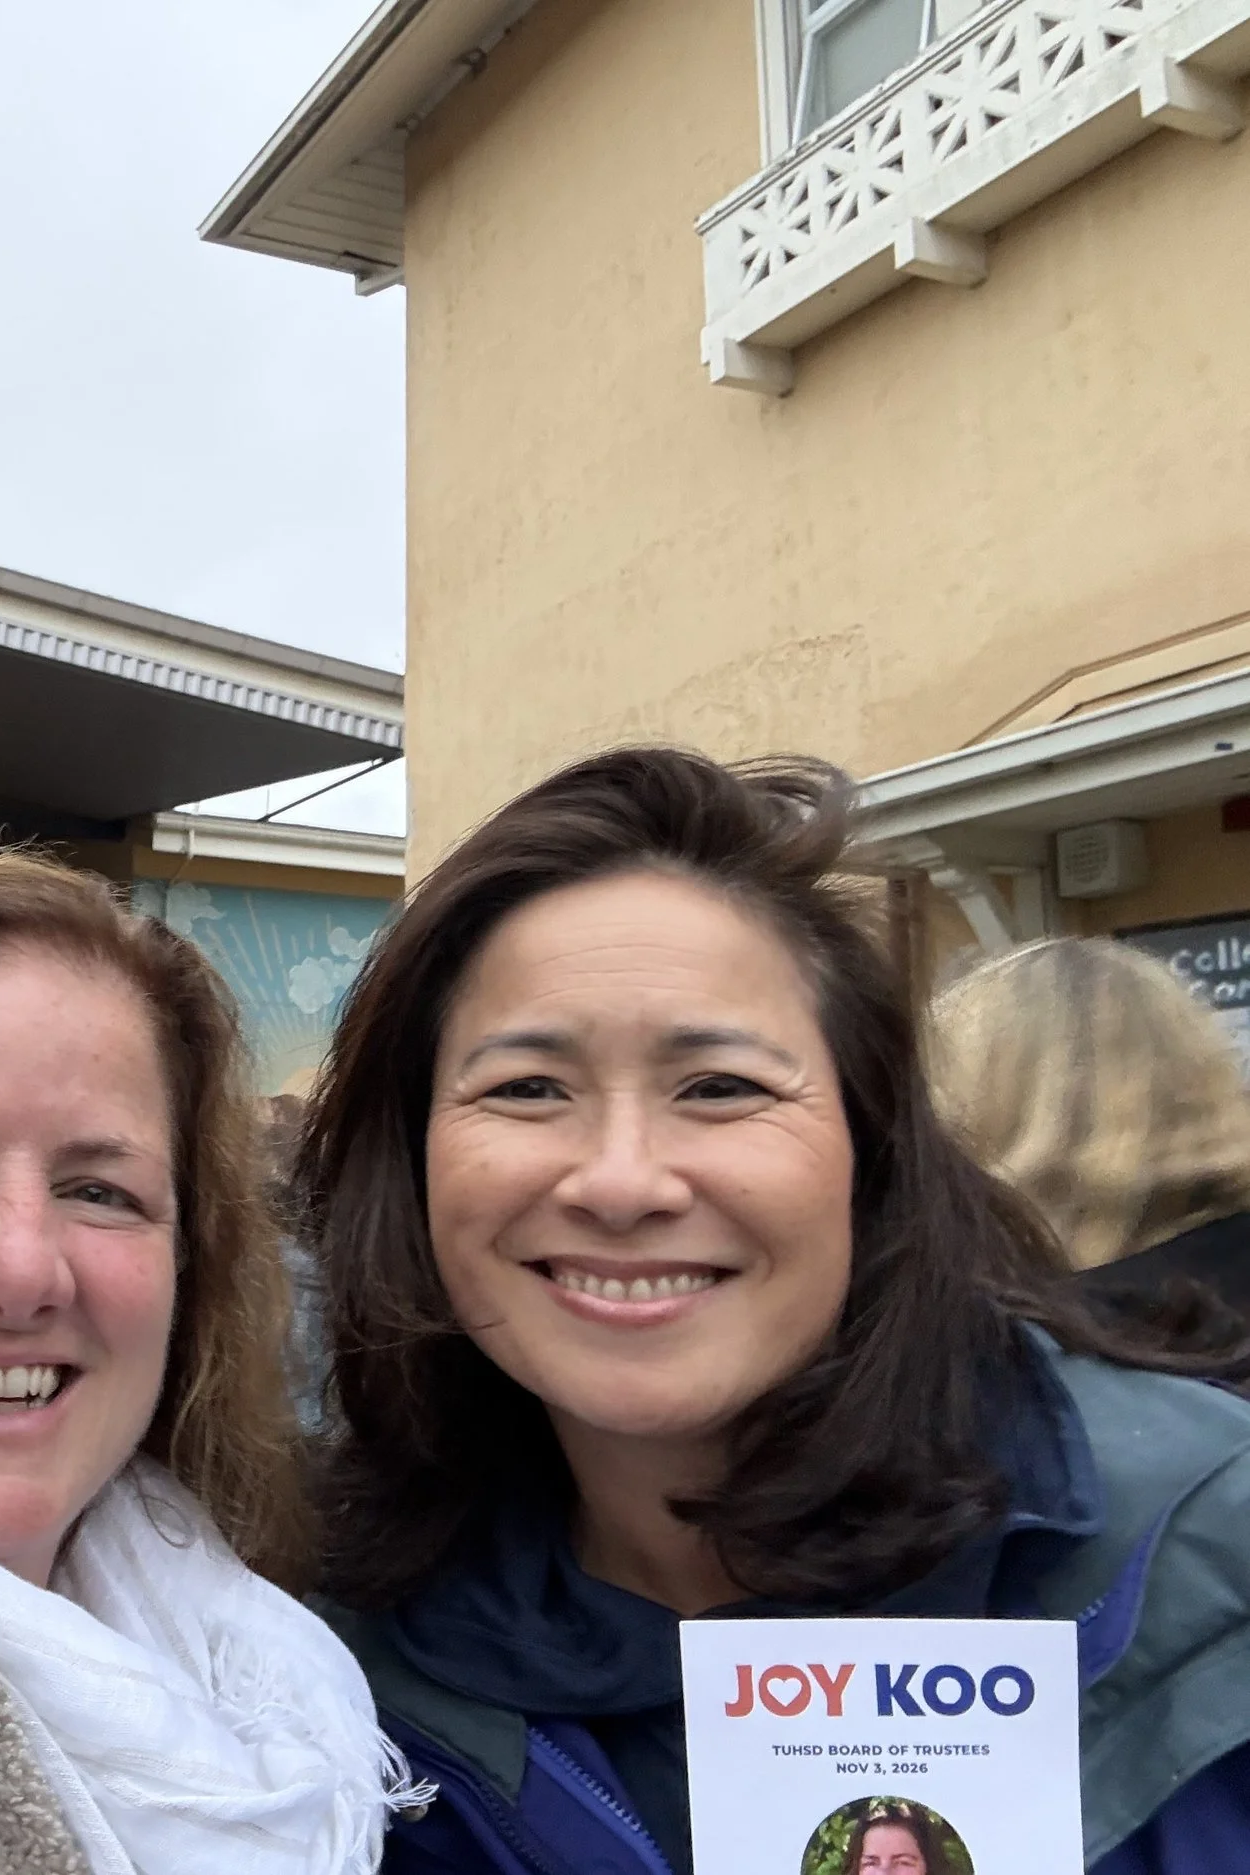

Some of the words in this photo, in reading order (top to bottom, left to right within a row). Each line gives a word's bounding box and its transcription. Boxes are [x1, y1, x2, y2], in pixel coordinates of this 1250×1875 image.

[724, 1663, 856, 1717] JOY
[874, 1663, 1036, 1717] KOO
[772, 1744, 823, 1757] TUHSD
[828, 1744, 883, 1757] BOARD
[888, 1744, 909, 1757] OF
[913, 1744, 991, 1757] TRUSTEES
[836, 1762, 869, 1775] NOV
[873, 1762, 887, 1776] 3,
[891, 1762, 929, 1775] 2026
